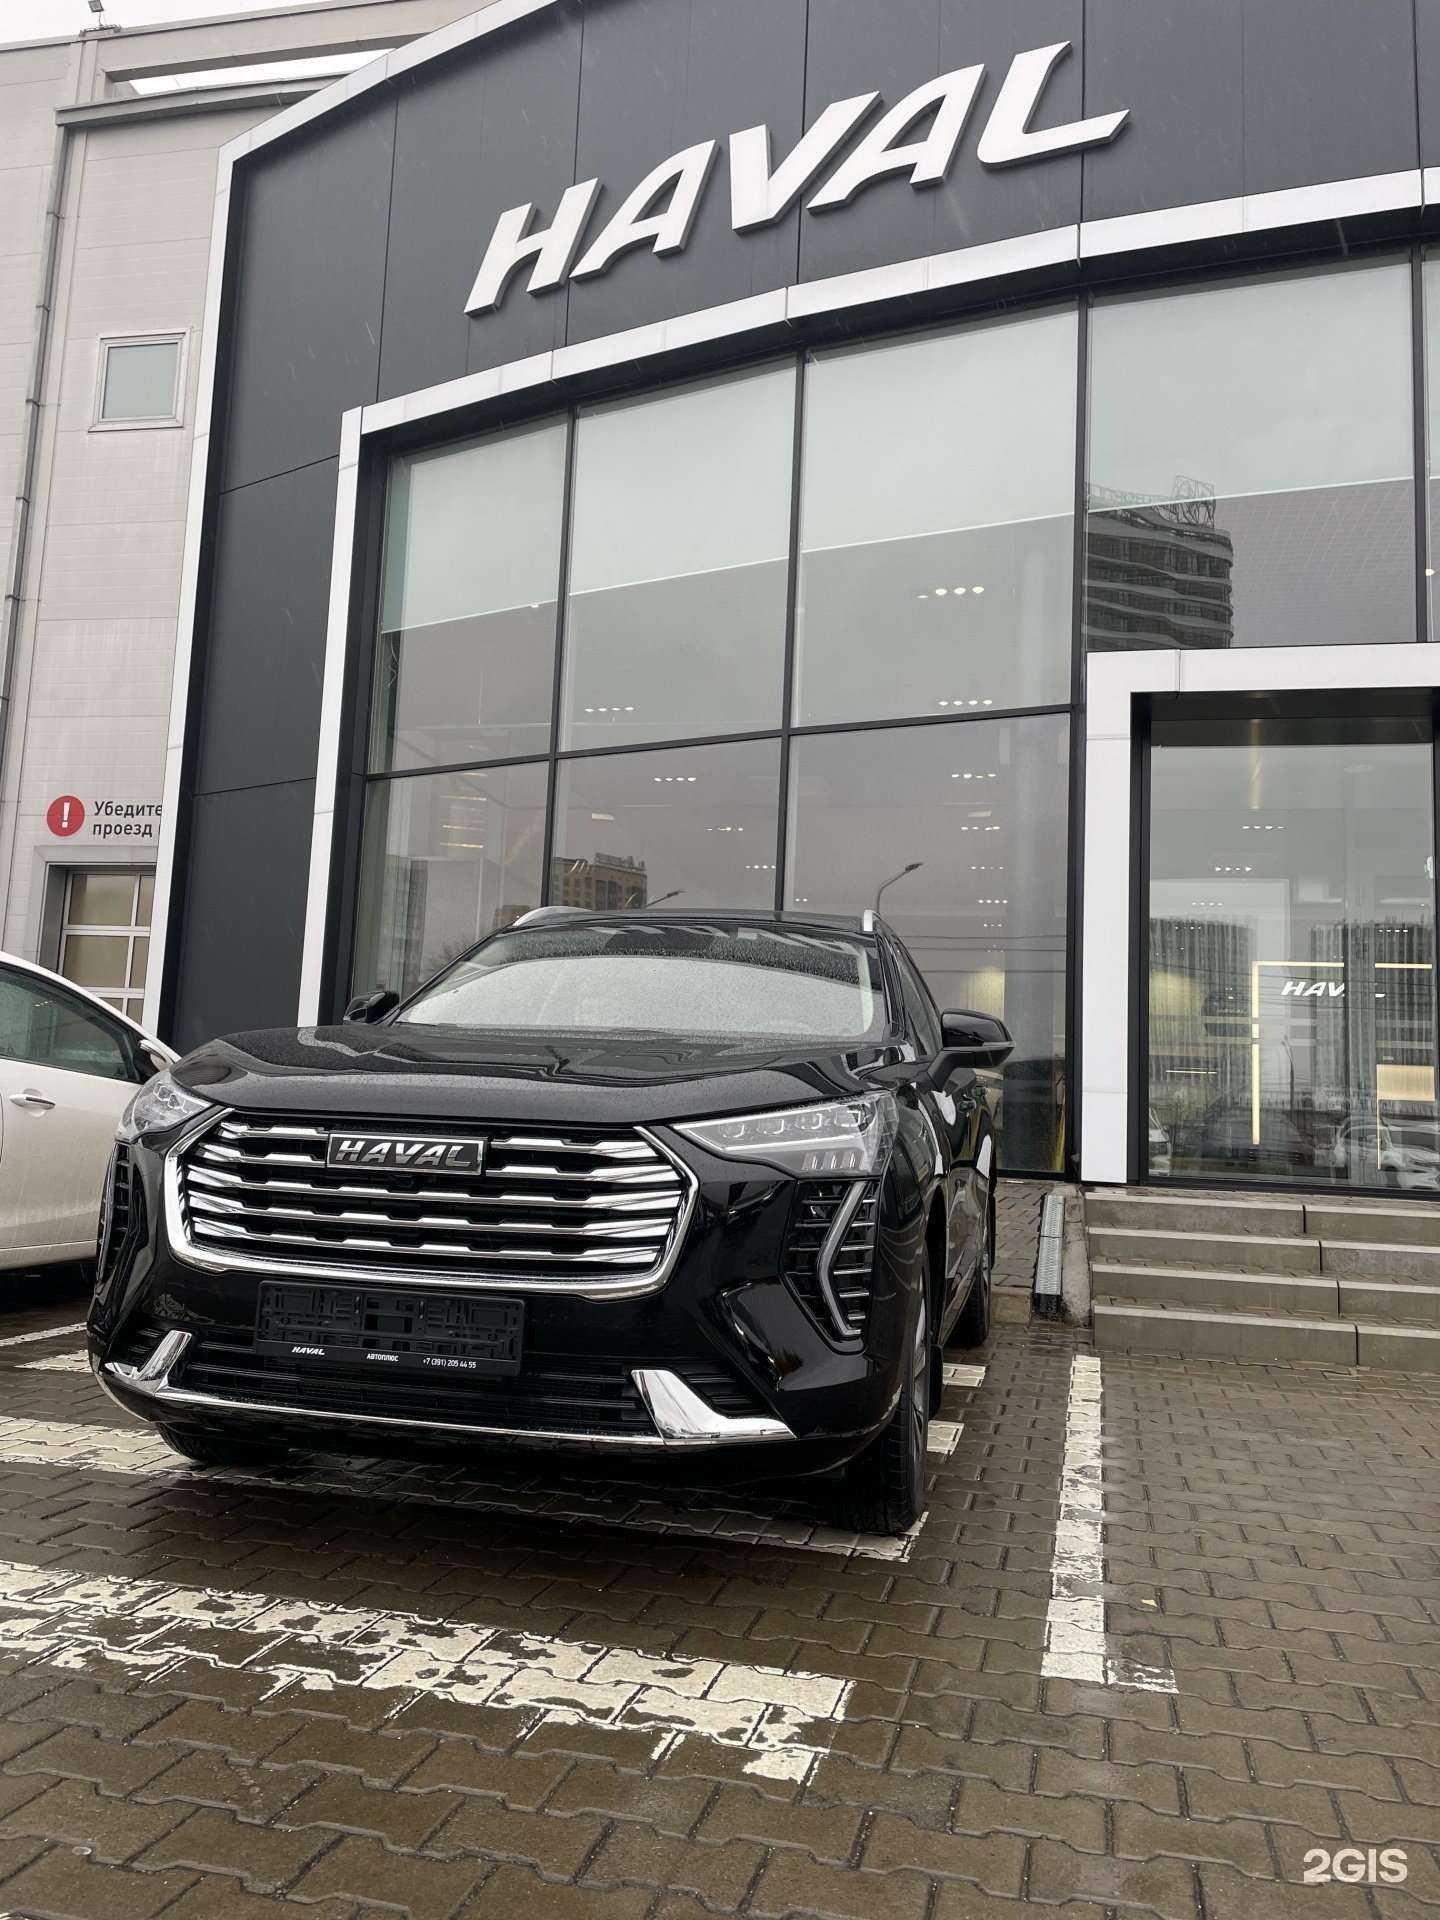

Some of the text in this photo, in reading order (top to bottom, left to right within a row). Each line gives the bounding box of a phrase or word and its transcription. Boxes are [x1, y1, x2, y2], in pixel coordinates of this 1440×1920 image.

[464, 41, 1131, 316] HAVAL
[93, 823, 152, 839] проезд
[1280, 981, 1385, 997] HAV
[336, 1140, 472, 1168] HAVAL
[291, 1346, 325, 1356] HAVAL
[366, 1353, 399, 1362] АВТОПЛЮС
